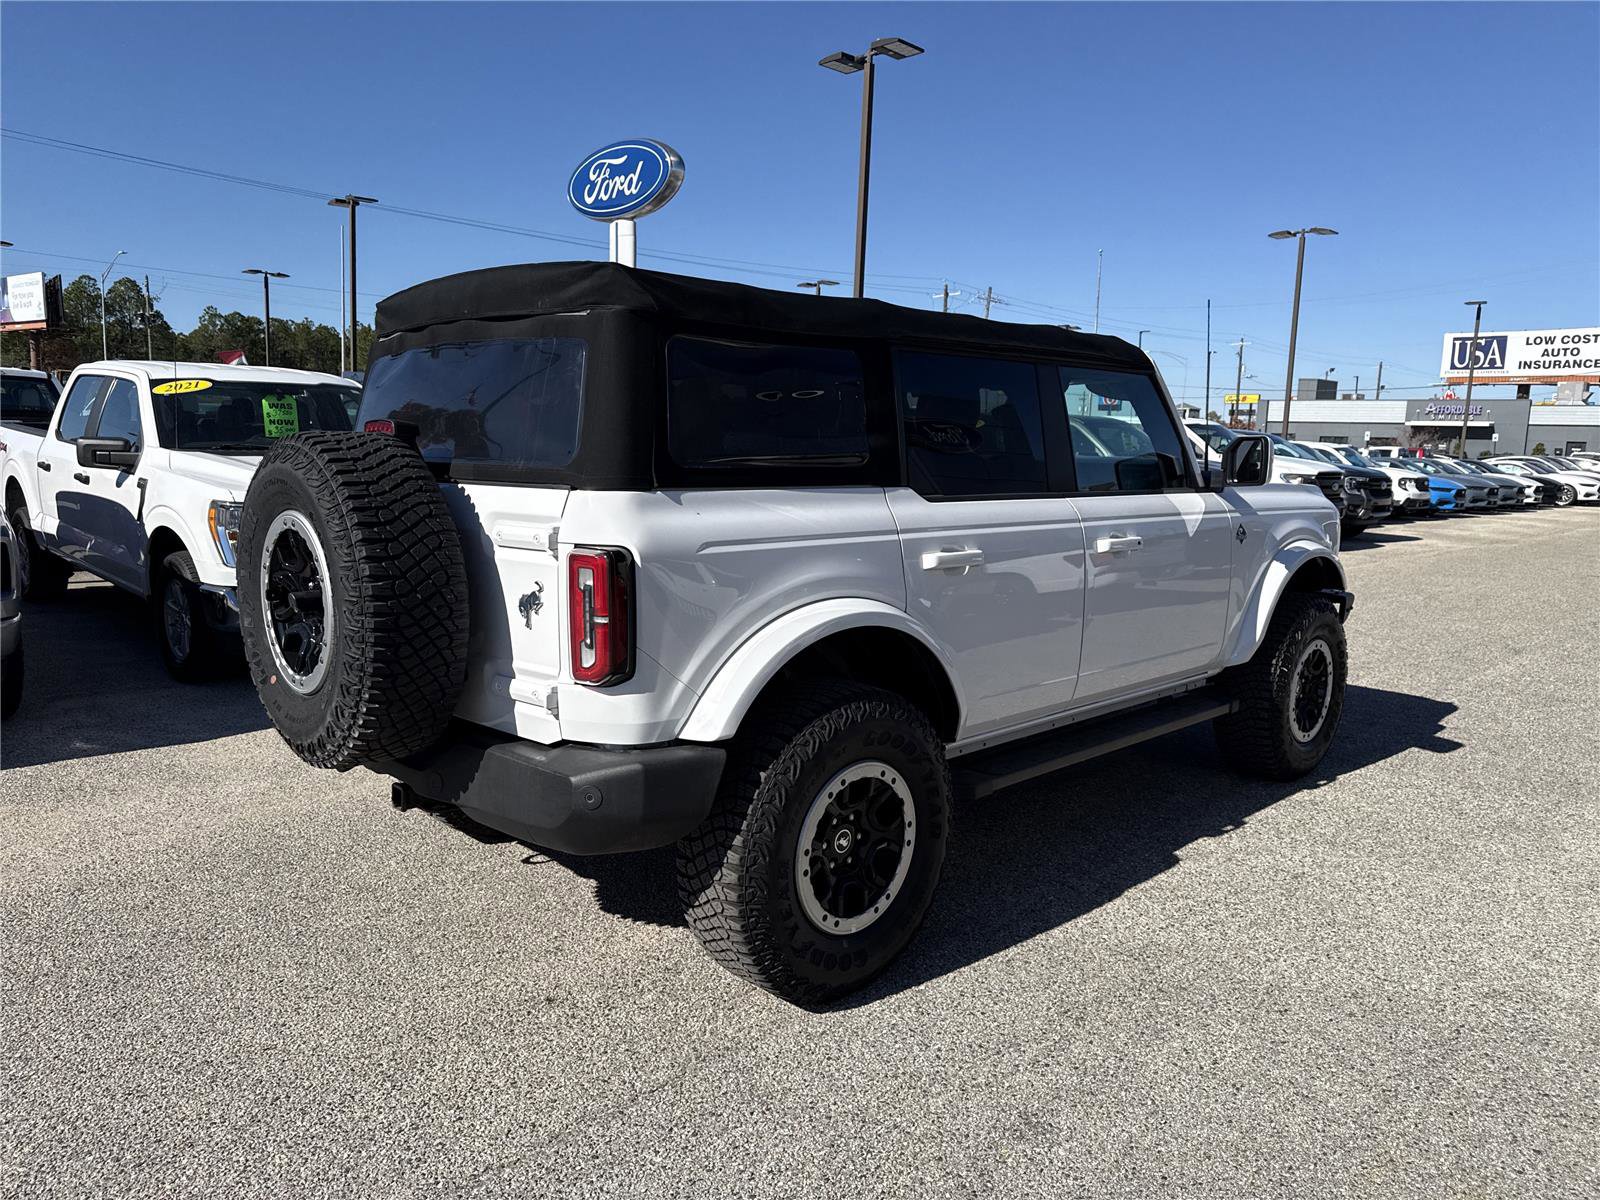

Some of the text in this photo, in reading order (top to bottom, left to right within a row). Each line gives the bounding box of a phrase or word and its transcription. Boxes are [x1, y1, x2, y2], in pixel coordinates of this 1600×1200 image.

[583, 154, 644, 205] Ford
[1525, 334, 1600, 346] LOW COST
[1453, 338, 1504, 369] USA
[1541, 347, 1581, 358] AUTO
[1518, 359, 1600, 370] INSURANCE
[165, 381, 200, 393] 2021
[268, 402, 293, 410] WAS
[1425, 402, 1482, 415] AFFORDBLE
[269, 418, 295, 426] NOW
